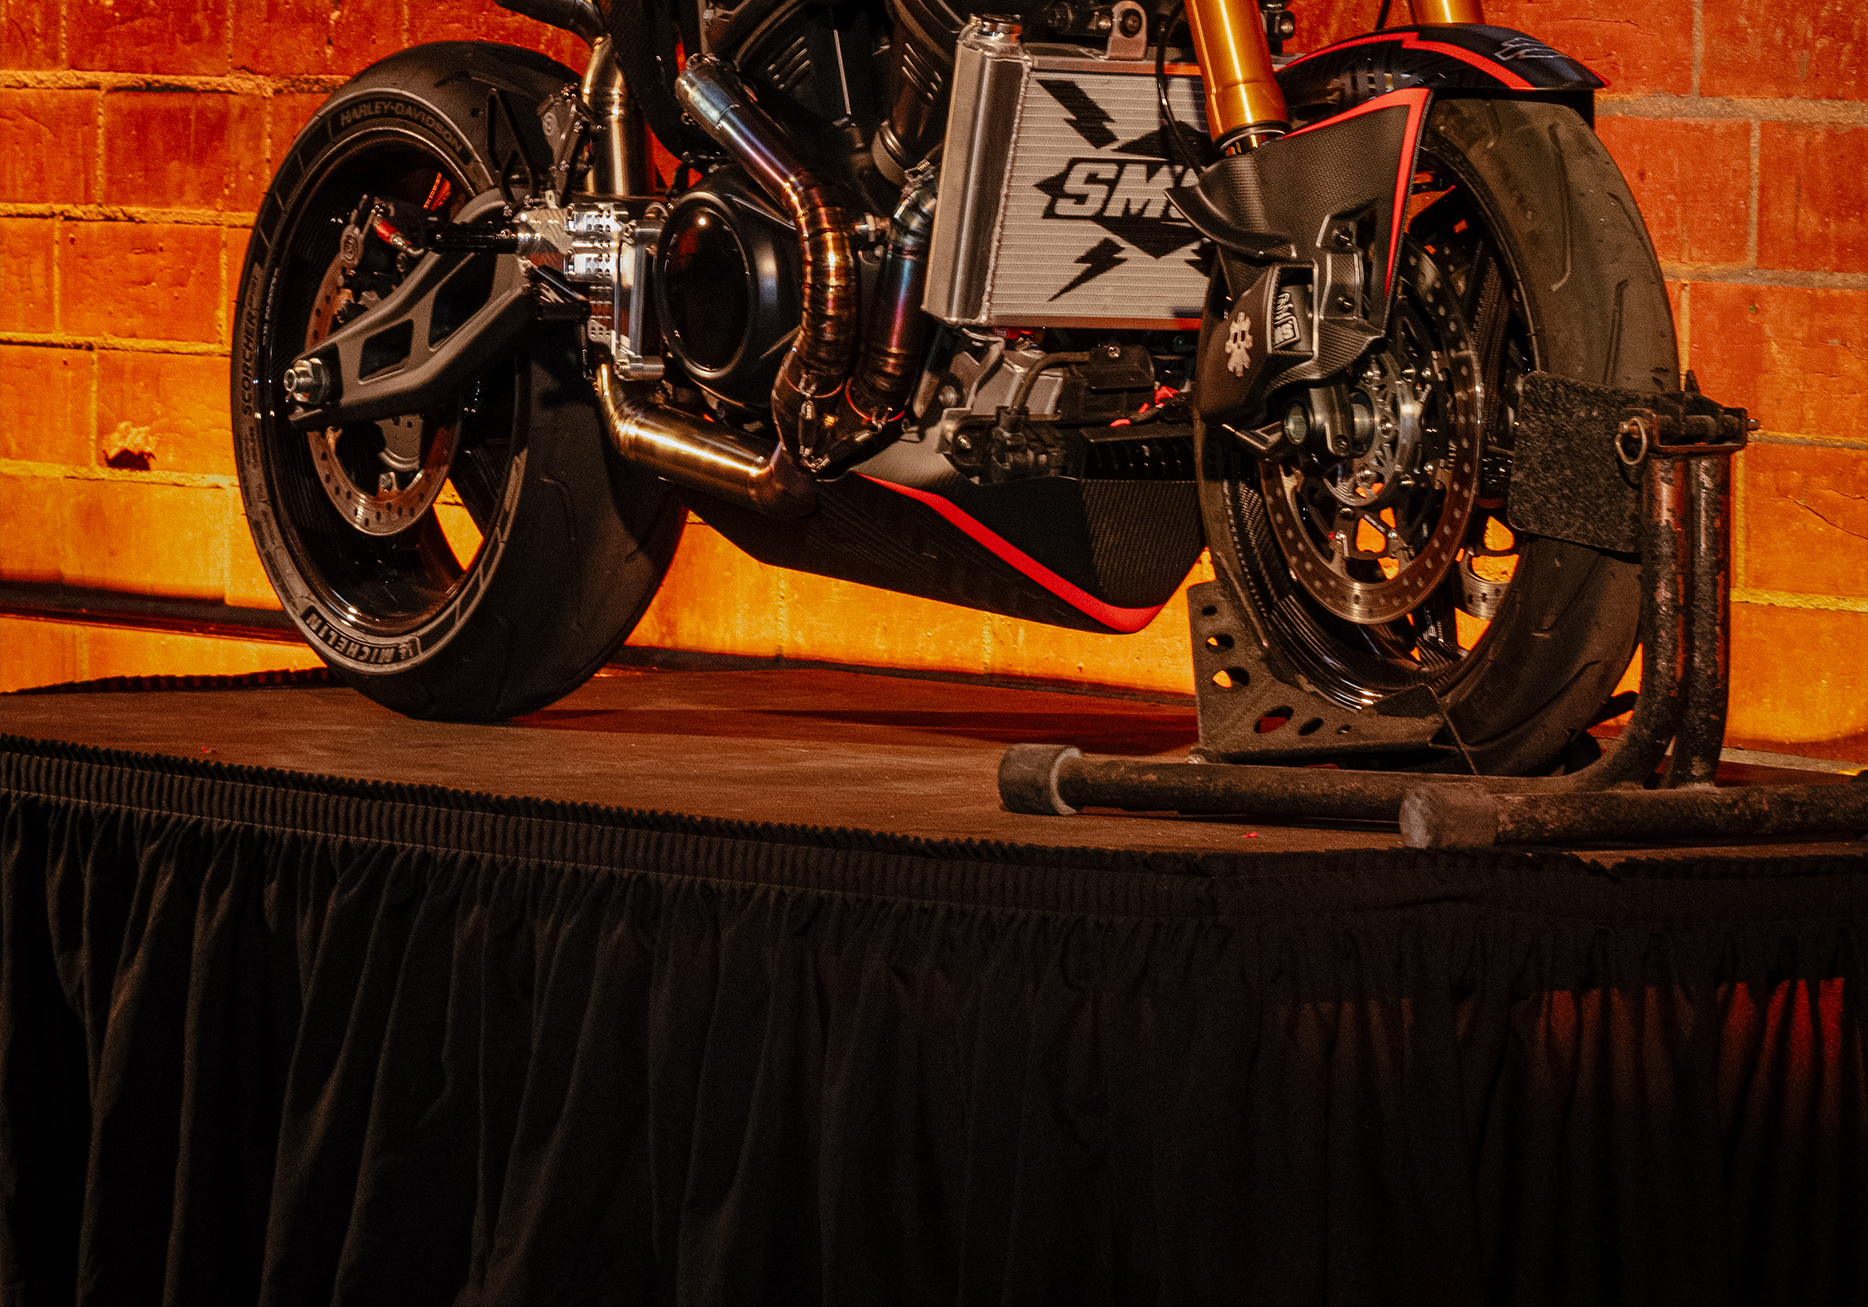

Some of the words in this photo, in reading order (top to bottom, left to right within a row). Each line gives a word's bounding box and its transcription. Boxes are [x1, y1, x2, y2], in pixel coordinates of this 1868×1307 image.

[340, 100, 463, 153] HARLEY-DAVIDSON
[241, 310, 256, 416] SCORCHER
[304, 612, 396, 664] MICHELIN
